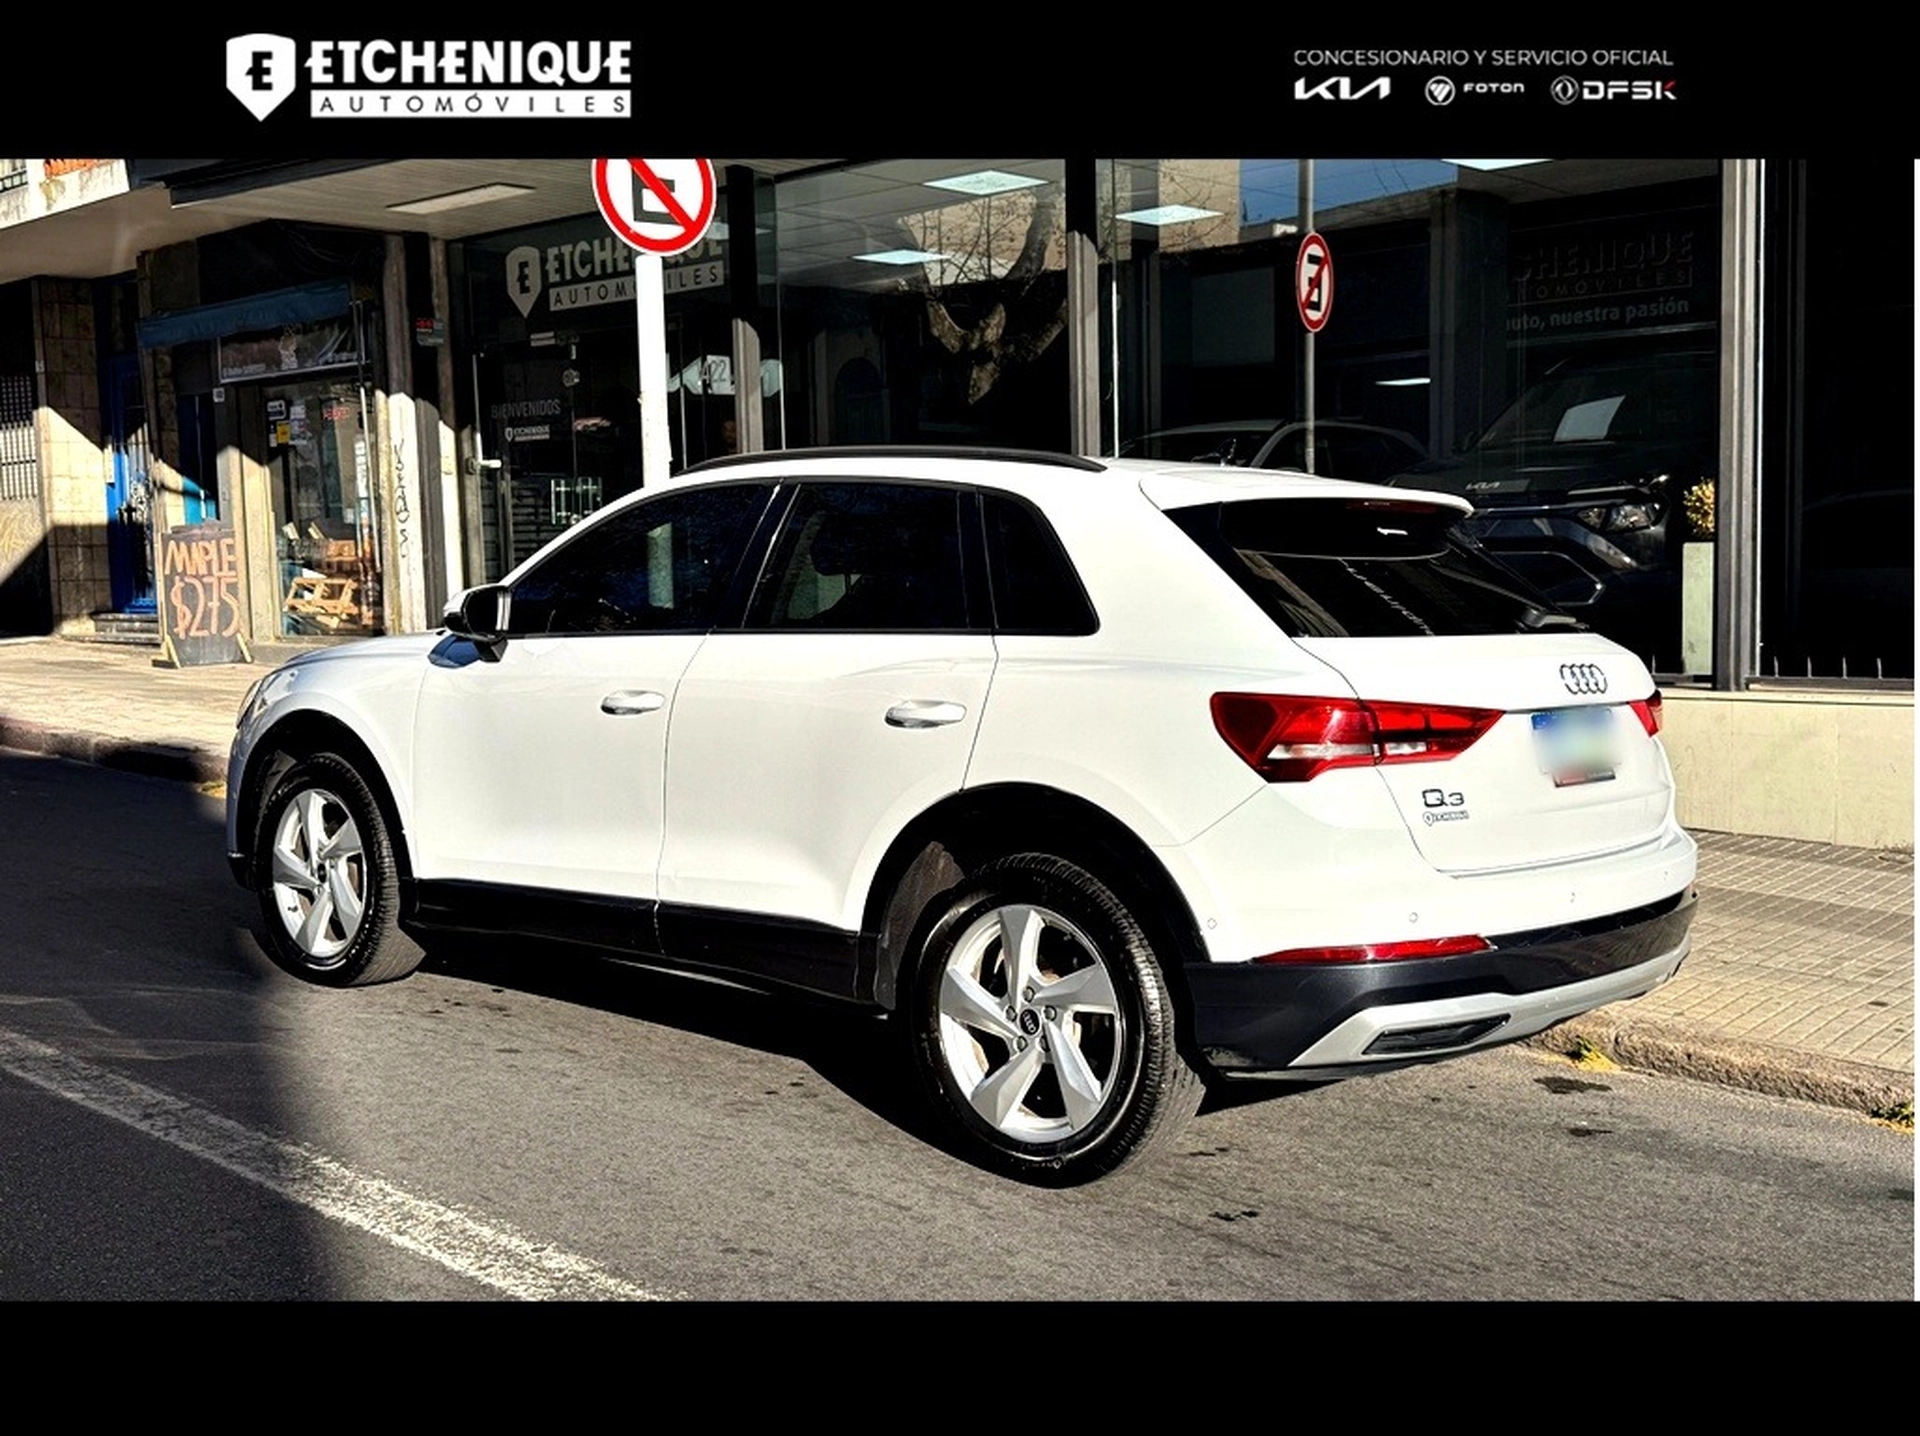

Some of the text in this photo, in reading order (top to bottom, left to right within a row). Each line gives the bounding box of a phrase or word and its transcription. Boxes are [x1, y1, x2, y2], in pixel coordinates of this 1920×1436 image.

[545, 236, 723, 283] ETCHEE
[554, 265, 718, 307] AUTOMILES
[1550, 307, 1621, 327] nuestra
[1625, 295, 1690, 325] pasión
[491, 398, 561, 419] BIENVENIDOS
[165, 538, 237, 575] MAPLE
[170, 576, 240, 640] $275
[1422, 788, 1465, 808] Q3
